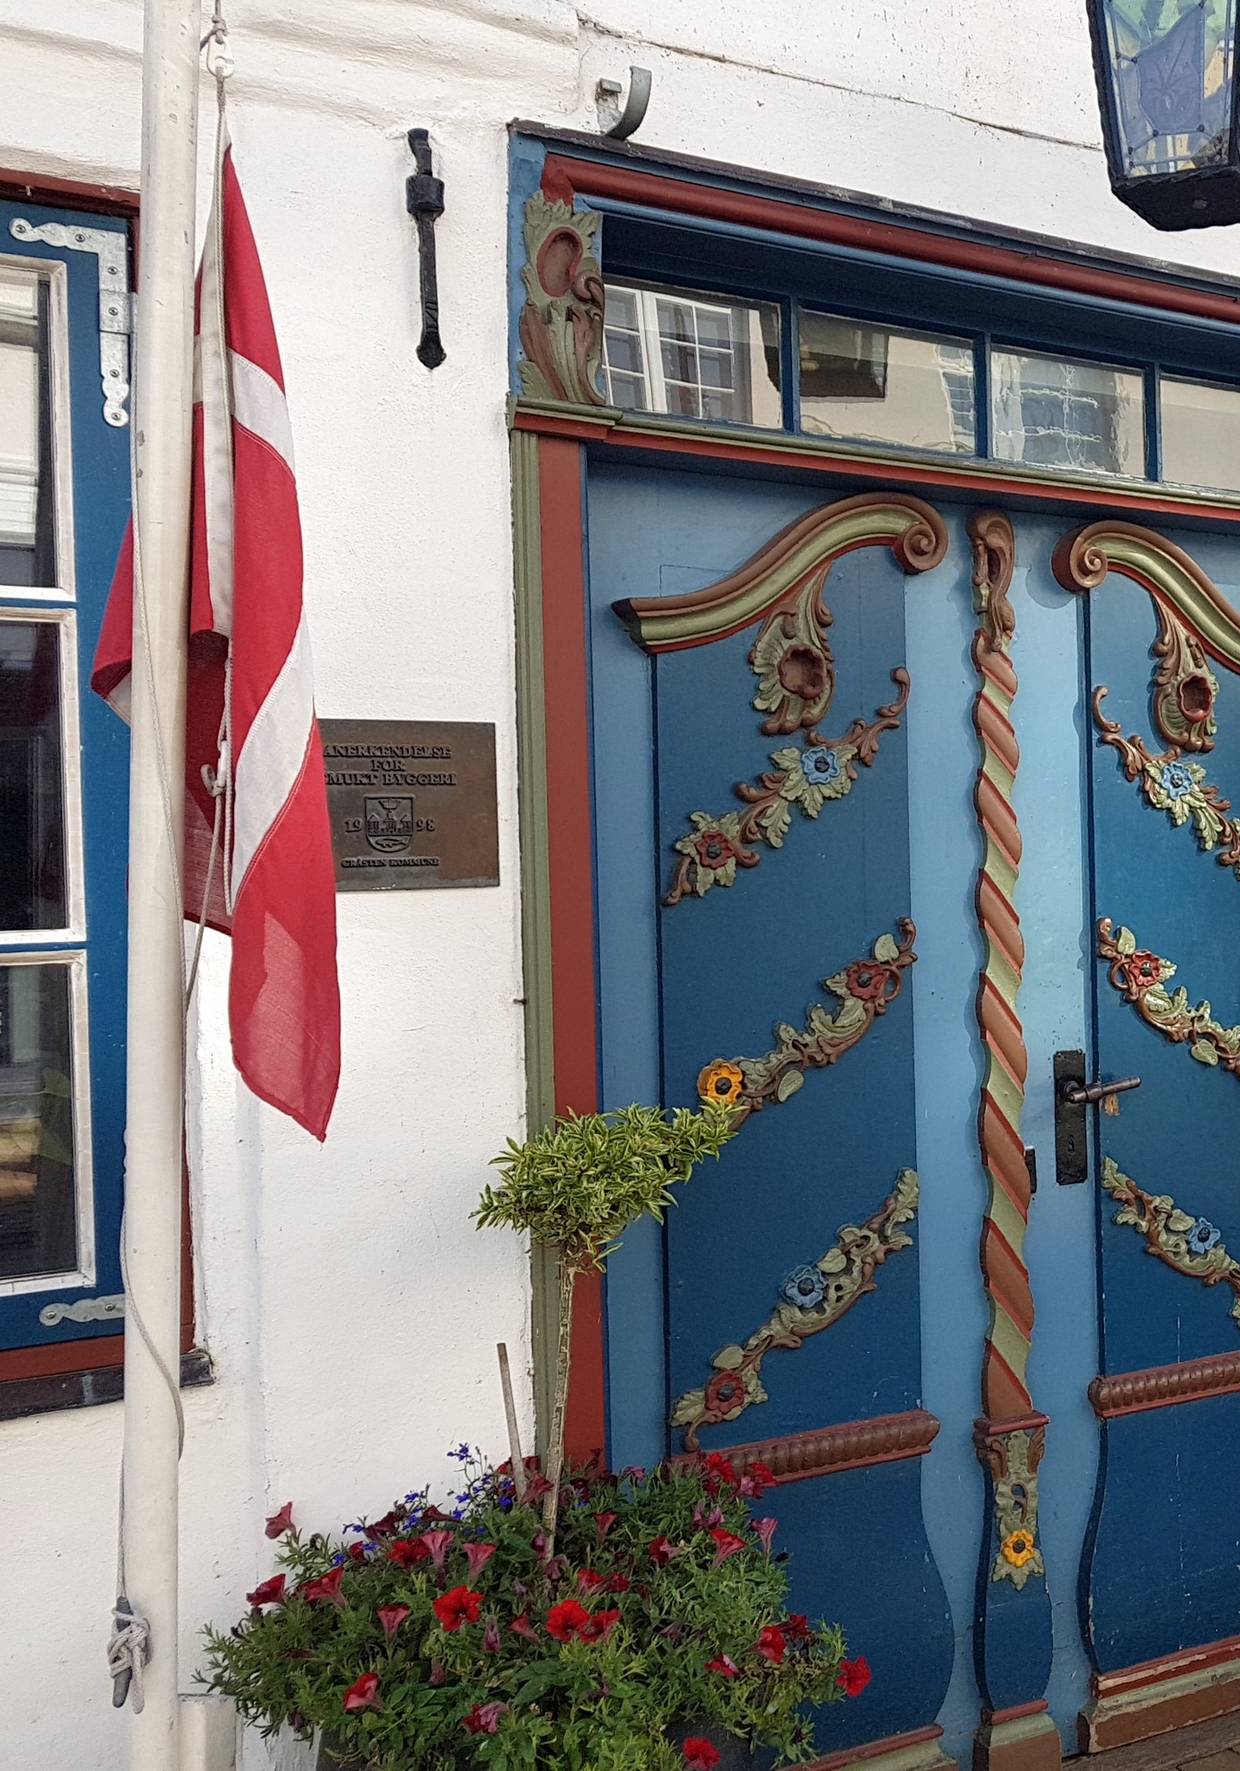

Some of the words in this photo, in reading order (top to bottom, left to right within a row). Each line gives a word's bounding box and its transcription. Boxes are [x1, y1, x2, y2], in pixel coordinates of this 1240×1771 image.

[323, 745, 451, 759] ANERKENDELSE
[371, 759, 406, 772] FOR
[325, 773, 379, 786] MUKT
[382, 773, 457, 786] BYGGERI
[344, 818, 363, 833] 19
